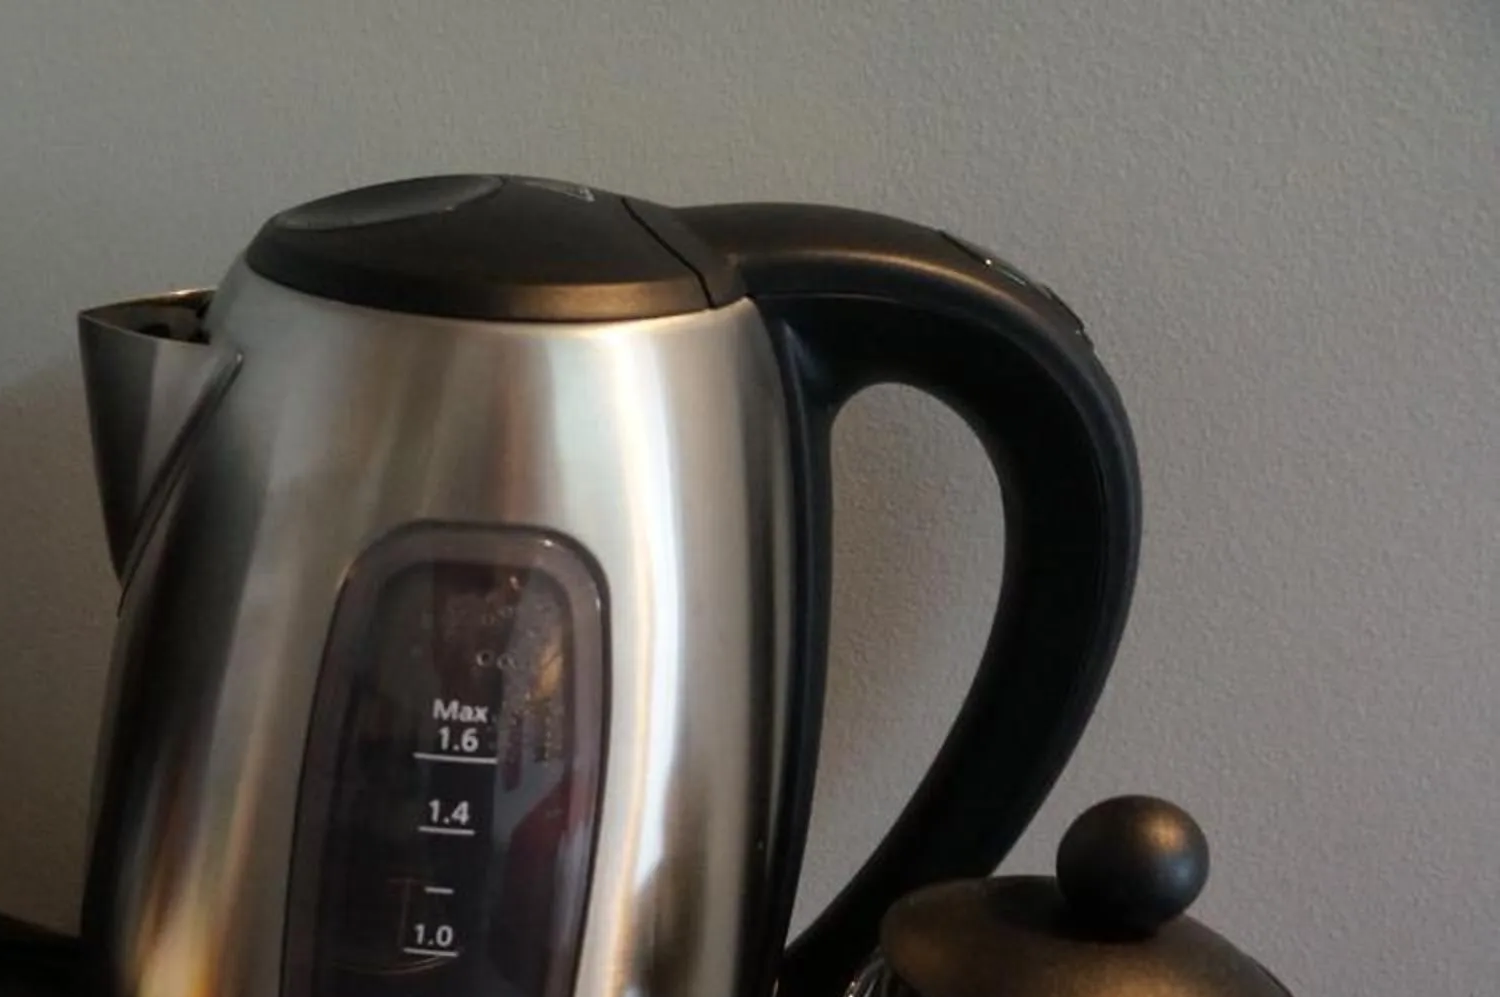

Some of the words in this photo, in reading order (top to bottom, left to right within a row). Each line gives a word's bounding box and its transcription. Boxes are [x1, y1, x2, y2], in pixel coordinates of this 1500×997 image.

[432, 698, 489, 724] Max
[438, 727, 480, 752] 1.6
[428, 799, 470, 826] 1.4
[413, 923, 455, 949] 1.0
